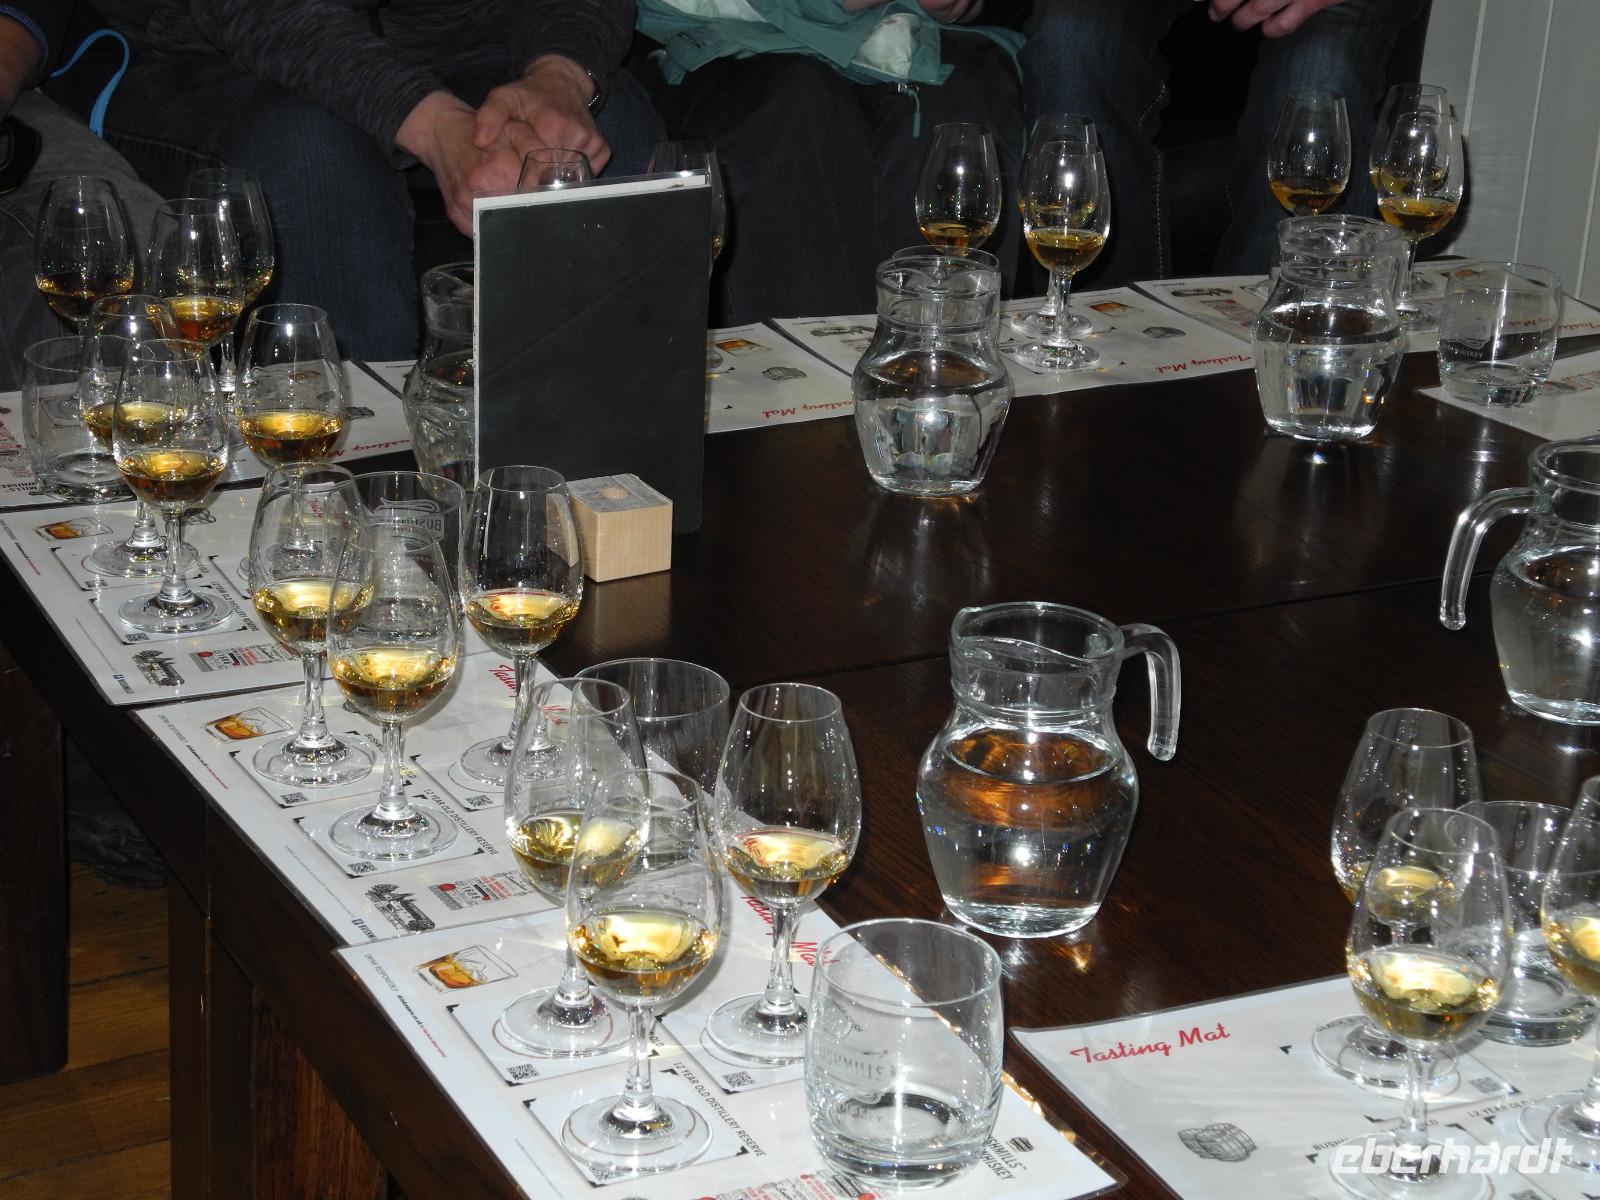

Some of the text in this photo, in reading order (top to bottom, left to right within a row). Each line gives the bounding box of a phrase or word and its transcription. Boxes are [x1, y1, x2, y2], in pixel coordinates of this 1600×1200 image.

[801, 399, 853, 411] asting
[351, 439, 410, 452] asting
[441, 804, 455, 814] OLD
[475, 835, 500, 855] RESERVE
[1069, 1022, 1231, 1064] Tasting Mat
[682, 1068, 699, 1088] YEAR
[695, 1083, 711, 1098] OLD
[705, 1096, 741, 1130] DISTILLERY
[736, 1128, 767, 1158] RESERVE
